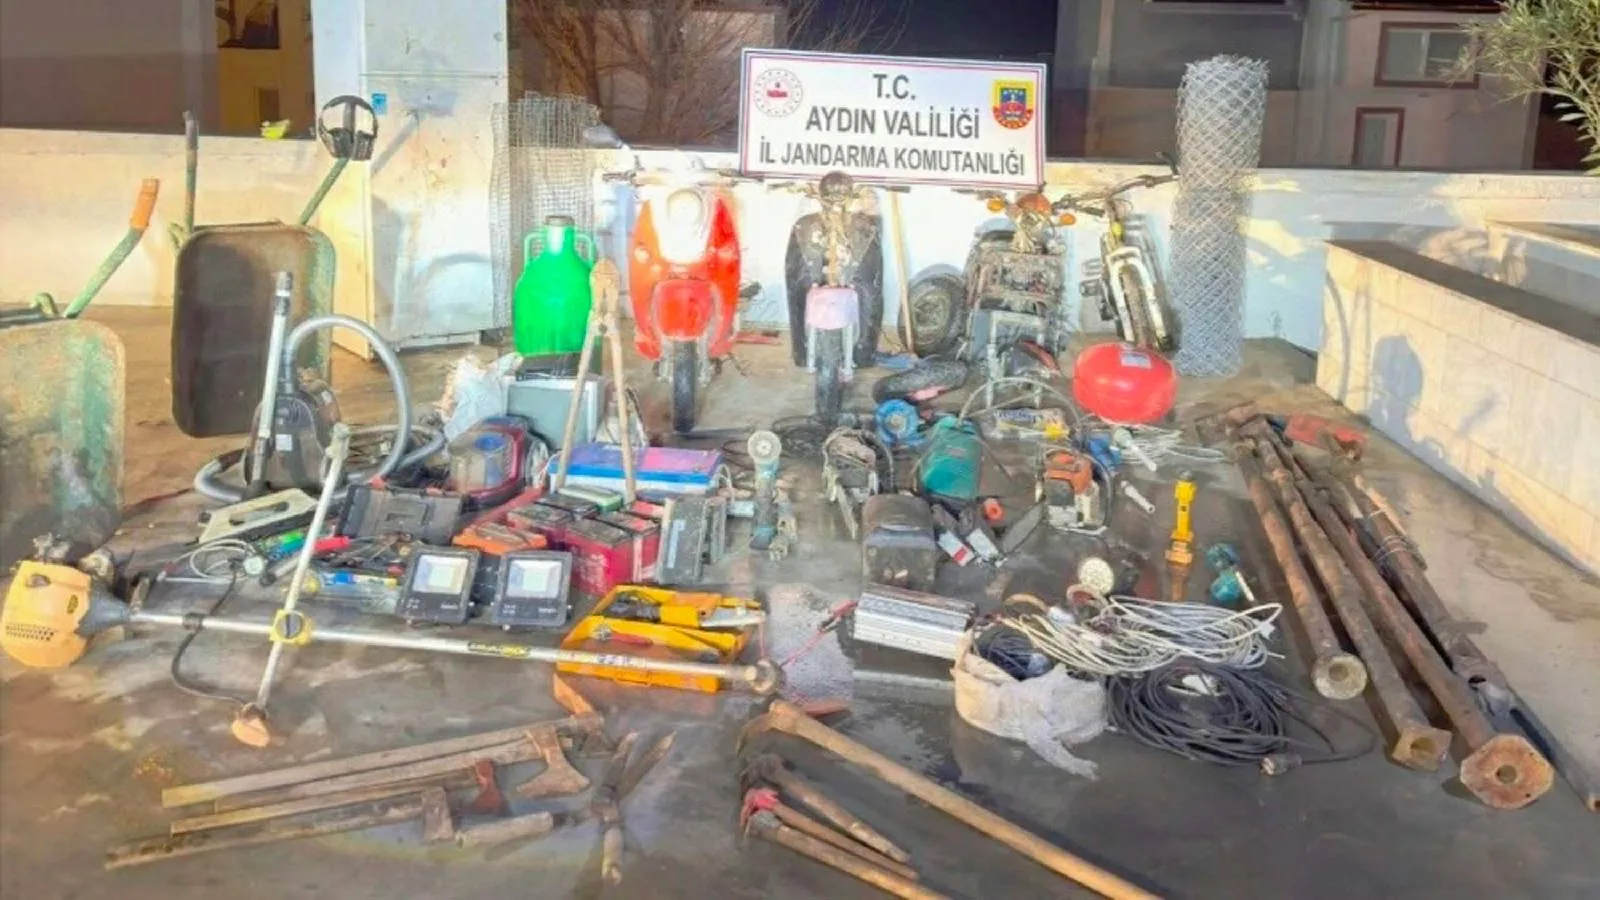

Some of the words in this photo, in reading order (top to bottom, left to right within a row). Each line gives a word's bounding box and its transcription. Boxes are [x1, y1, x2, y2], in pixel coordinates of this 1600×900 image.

[873, 73, 916, 100] T.C.
[805, 105, 875, 134] AYDIN
[883, 105, 980, 139] VALİLİĞİ
[760, 136, 776, 164] İL
[781, 142, 890, 169] JANDARMA
[894, 147, 1025, 176] KOMUTANLIĞI
